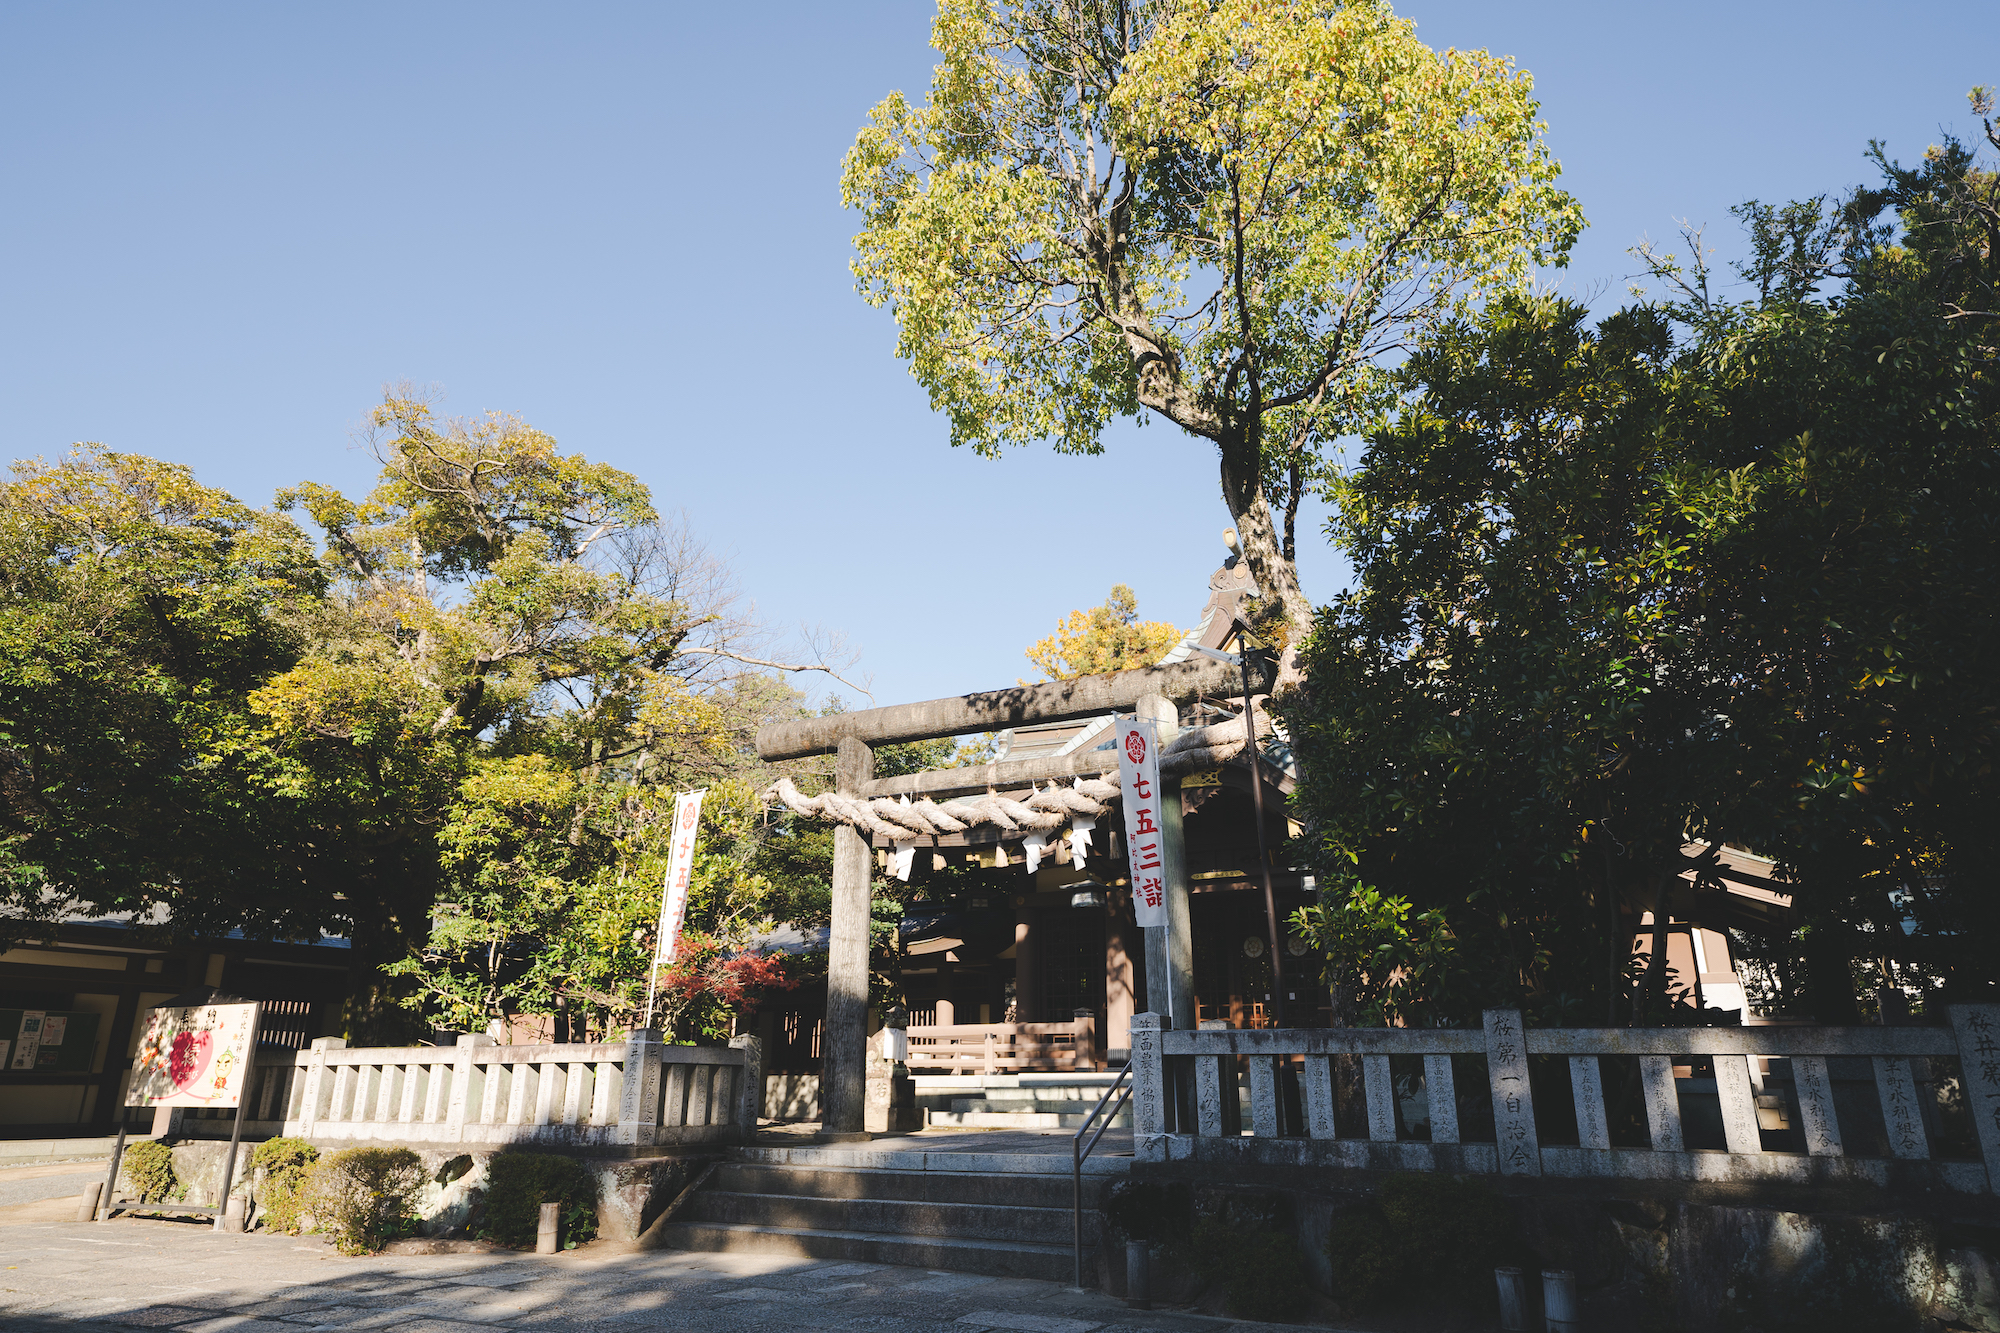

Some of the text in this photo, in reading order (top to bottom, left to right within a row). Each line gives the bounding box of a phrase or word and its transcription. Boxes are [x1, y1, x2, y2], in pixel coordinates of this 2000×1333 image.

[1130, 833, 1142, 898] 阿比太神社
[1133, 772, 1162, 908] 七五三詣
[177, 1070, 199, 1080] むすび
[1493, 1014, 1532, 1168] 桜第一自治会
[1802, 1059, 1832, 1148] 新稲水利組合
[1885, 1057, 1918, 1150] 半町水利組合
[1967, 1010, 2000, 1147] 桜井第一自
